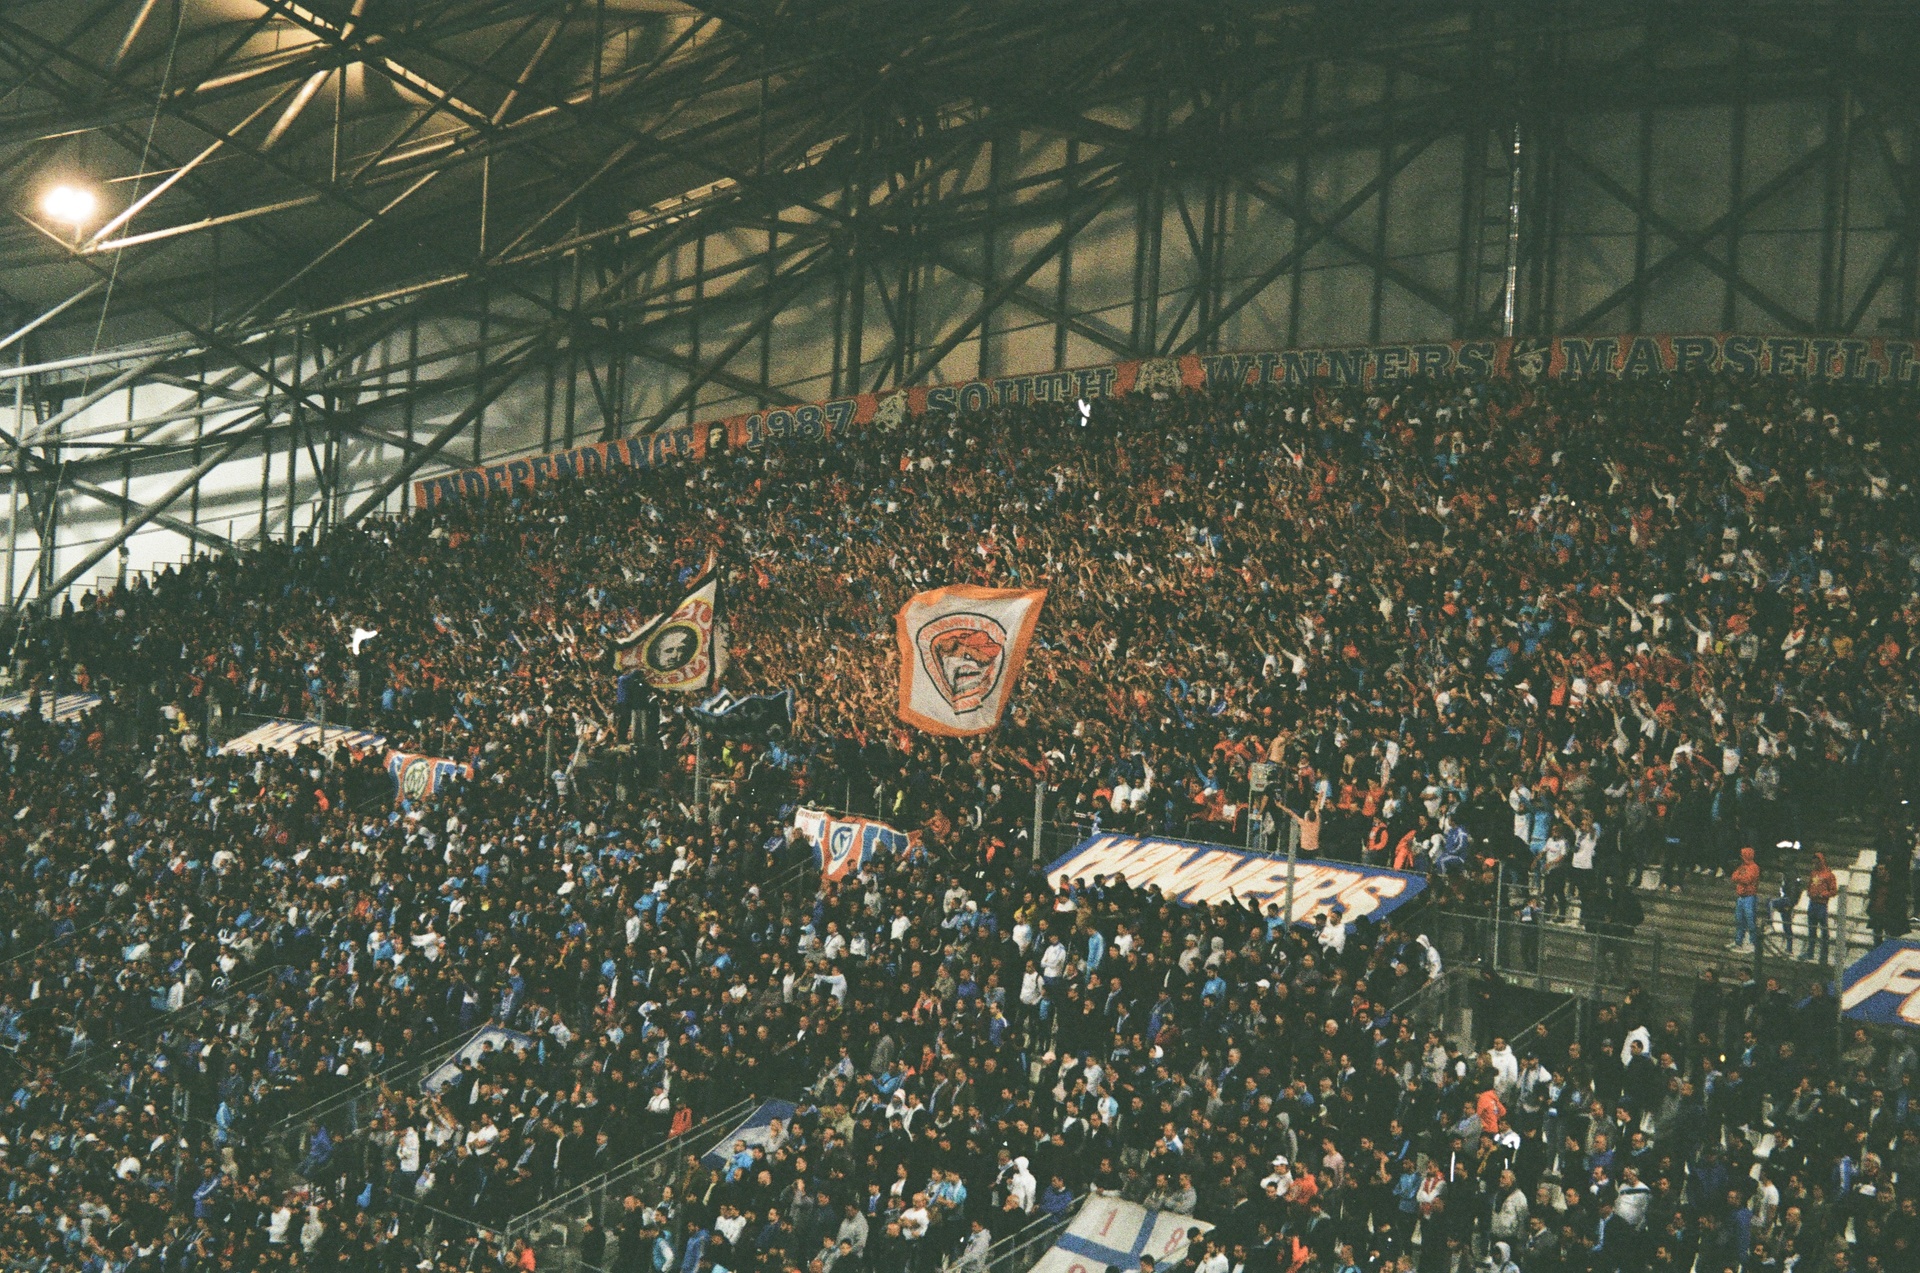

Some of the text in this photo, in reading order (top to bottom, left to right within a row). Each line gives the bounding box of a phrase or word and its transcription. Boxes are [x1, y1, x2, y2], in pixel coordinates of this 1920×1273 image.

[422, 423, 695, 512] INDEPENDANCE
[746, 400, 857, 452] 1987
[926, 365, 1119, 413] SOUTH
[1201, 341, 1496, 390] WINNERS
[1099, 1208, 1185, 1254] 1 8
